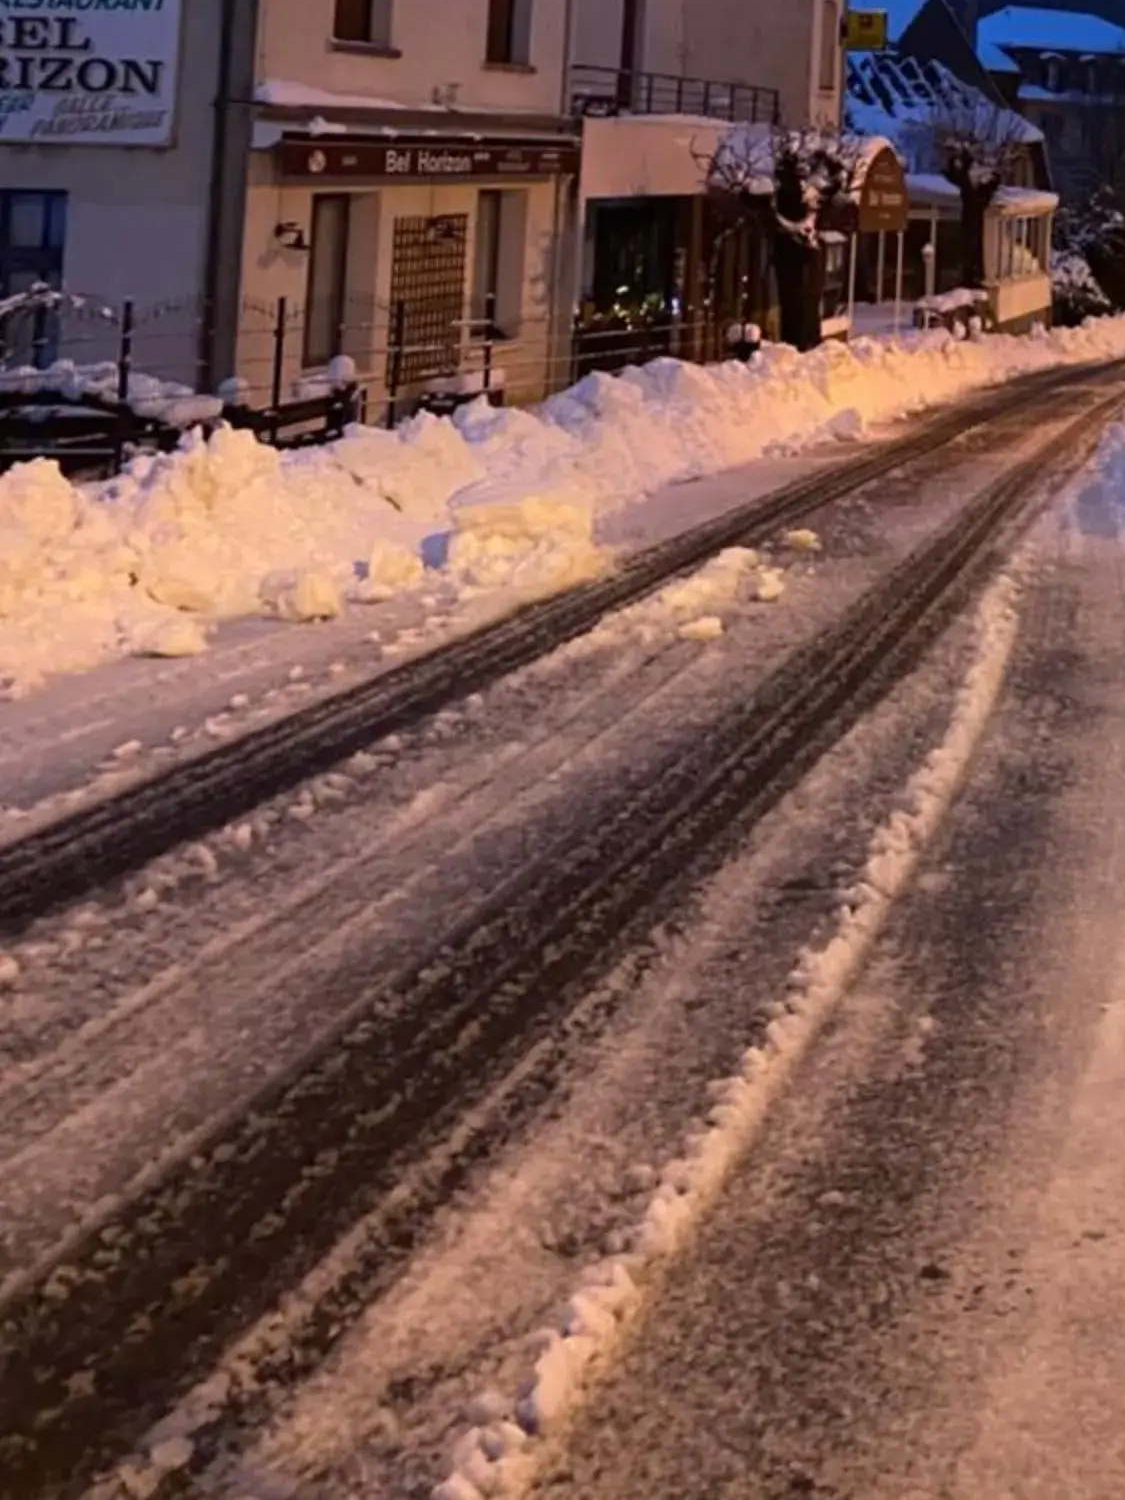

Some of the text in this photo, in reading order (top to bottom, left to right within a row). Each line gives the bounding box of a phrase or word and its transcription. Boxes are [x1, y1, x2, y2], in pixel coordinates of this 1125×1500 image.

[0, 15, 92, 51] EL
[386, 148, 411, 173] Bel
[418, 149, 473, 174] Horizon
